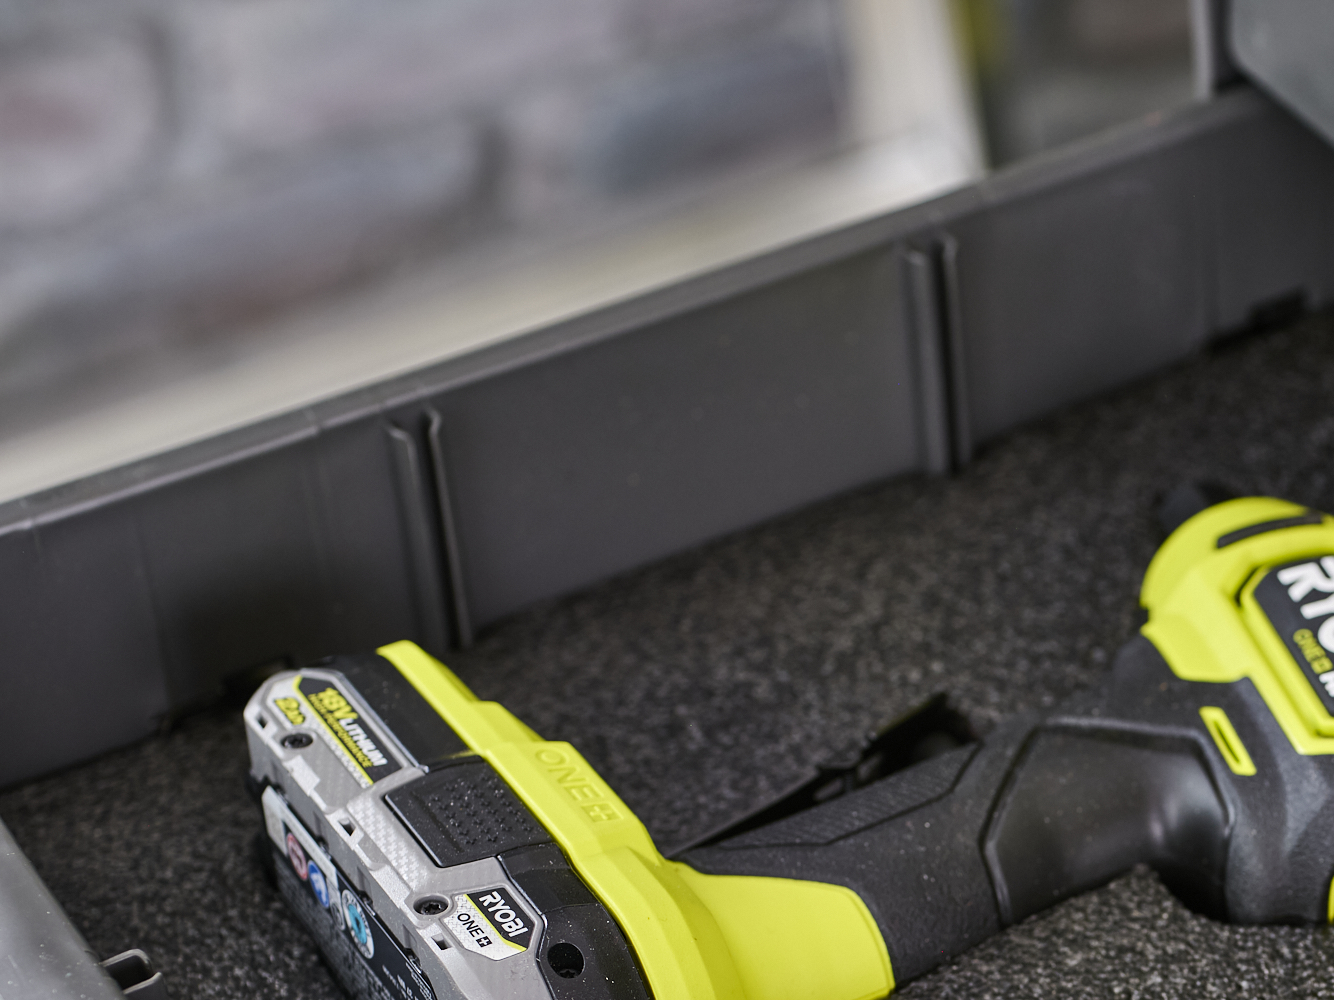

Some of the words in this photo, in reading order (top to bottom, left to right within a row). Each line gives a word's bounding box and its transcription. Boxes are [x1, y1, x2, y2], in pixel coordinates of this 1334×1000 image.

[317, 687, 359, 720] 18V
[339, 717, 388, 767] LITHIUM
[479, 891, 528, 938] RYOBI
